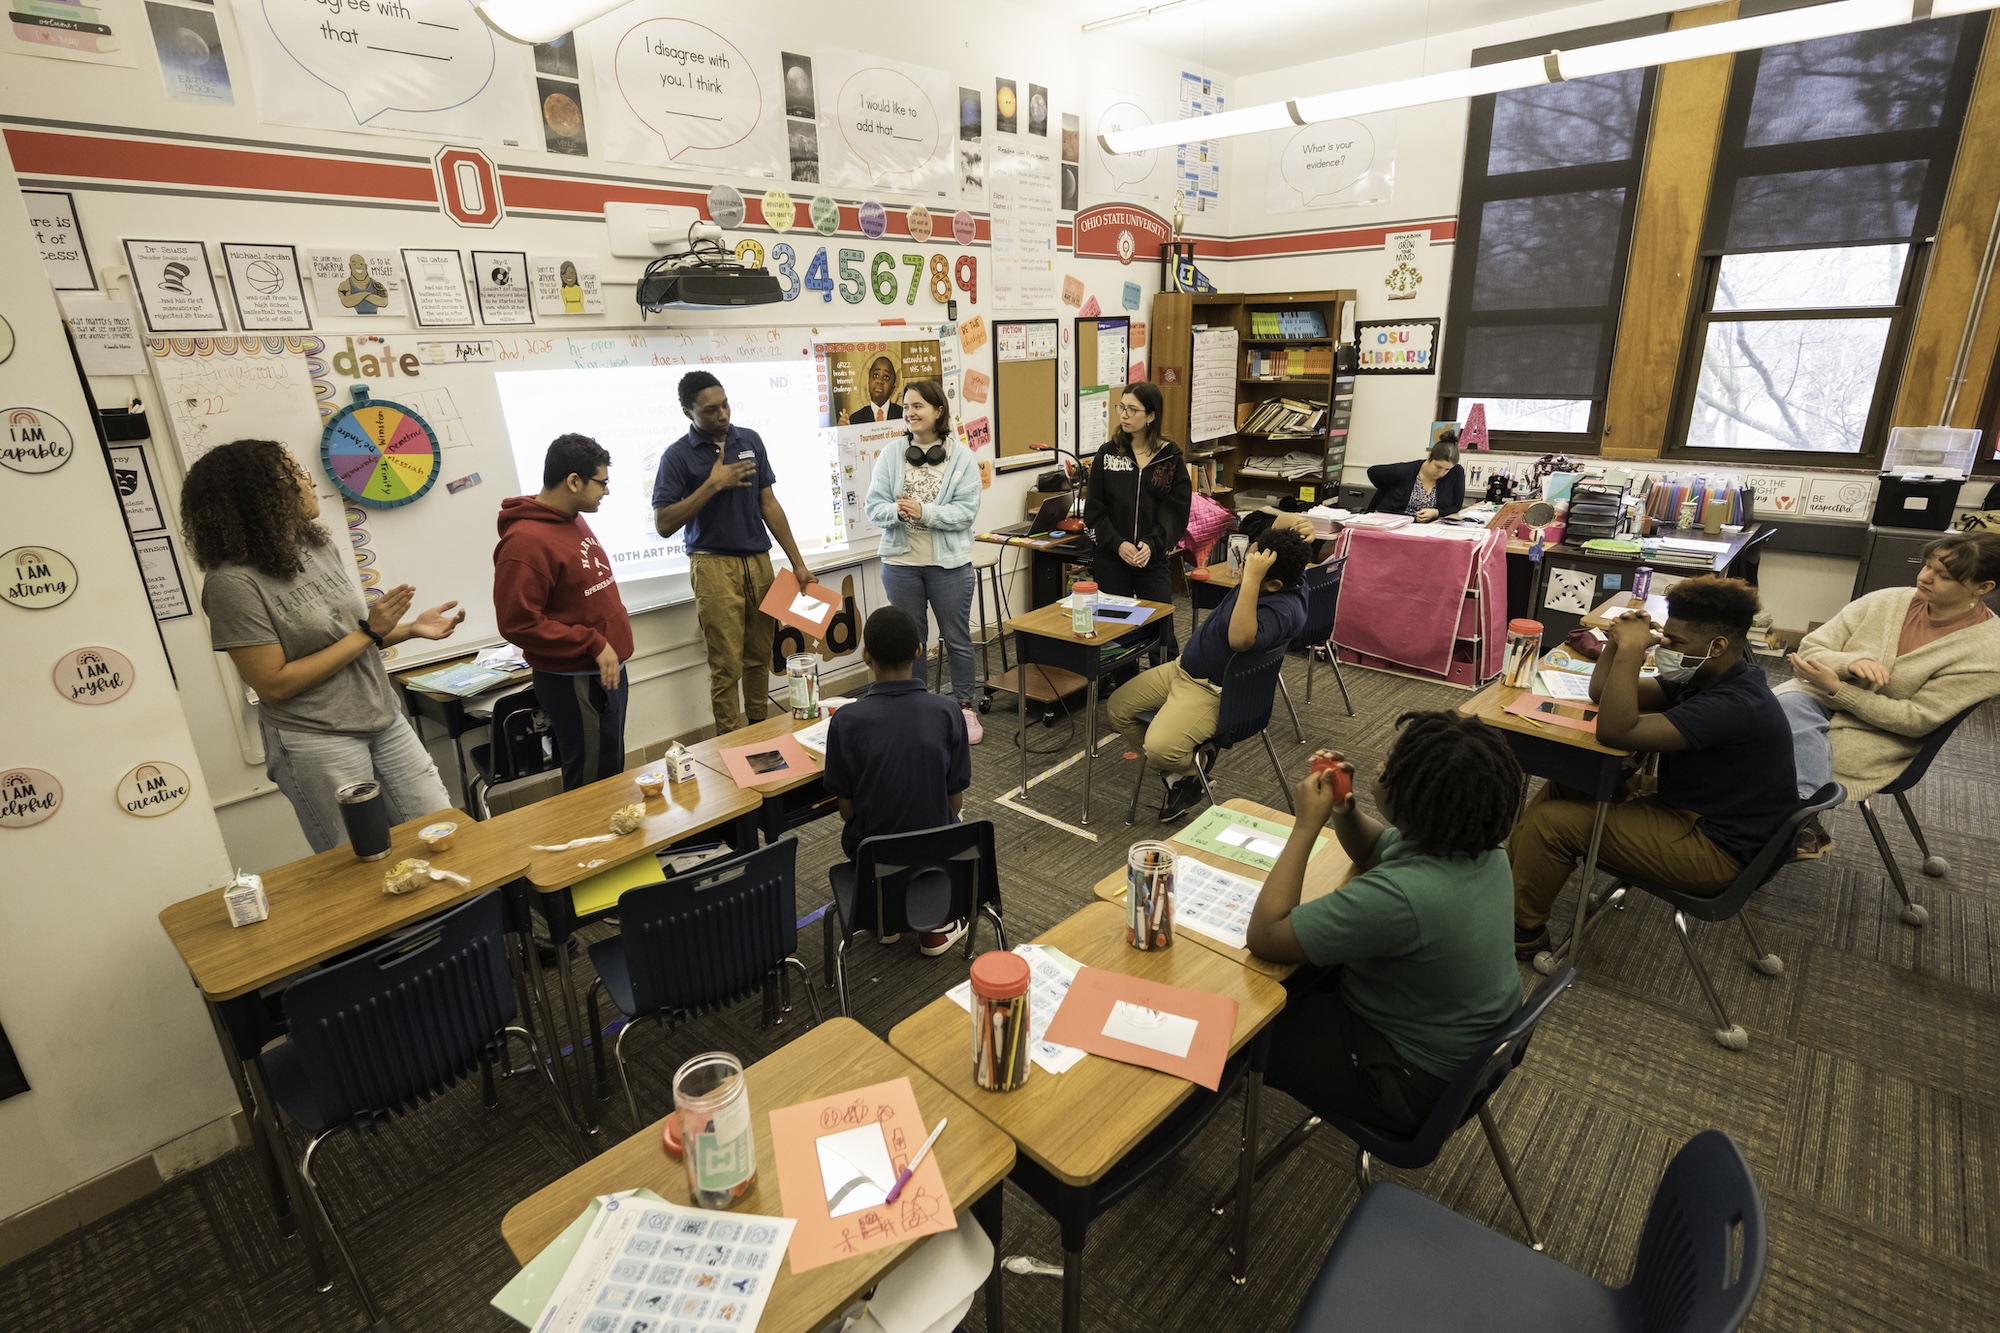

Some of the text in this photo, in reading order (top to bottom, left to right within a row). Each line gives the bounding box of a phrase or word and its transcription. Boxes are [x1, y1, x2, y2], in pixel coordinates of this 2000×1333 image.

[377, 0, 411, 20] with
[320, 20, 359, 45] that
[646, 36, 730, 69] I disagree with
[178, 75, 218, 88] EARTH'S
[185, 83, 215, 95] MOON
[660, 72, 723, 95] you. I think
[861, 94, 917, 118] I would like to
[856, 120, 893, 136] add that
[998, 146, 1015, 159] Reading
[1302, 140, 1354, 154] What is your
[1306, 155, 1346, 171] evidence?
[56, 216, 71, 228] is
[1081, 213, 1167, 239] OHIO STATE UNIVERSITY
[50, 234, 66, 245] of
[1398, 240, 1416, 251] GROW
[144, 246, 188, 255] Dr. Seuss
[264, 252, 291, 263] Jordan
[1396, 252, 1415, 263] MIND
[313, 262, 345, 273] POWERFUL
[429, 256, 449, 264] Gates
[772, 243, 801, 302] 3
[805, 246, 834, 303] 4
[838, 248, 867, 304] 5
[871, 251, 898, 305] 6
[903, 254, 924, 305] 7
[930, 253, 953, 304] 8
[956, 255, 978, 305] 9
[163, 305, 202, 313] manuscript
[243, 308, 277, 316] basketball
[254, 301, 290, 310] high school
[154, 313, 183, 321] rejected
[960, 317, 981, 336] BE THE
[1002, 326, 1022, 335] FICTION
[591, 339, 617, 353] open
[1377, 331, 1409, 345] OSU
[333, 336, 421, 379] date
[455, 343, 485, 362] April
[526, 339, 553, 357] 2025
[180, 358, 289, 382] Affirmations
[203, 395, 230, 415] 22
[10, 428, 46, 442] I AM
[378, 410, 386, 447] Winston
[966, 422, 989, 440] hard
[1459, 403, 1490, 451] A
[860, 431, 885, 443] Tournament
[886, 430, 891, 438] of
[381, 460, 391, 495] Trinity
[1751, 478, 1786, 489] DO THE
[1752, 486, 1777, 496] IGHT
[1753, 494, 1768, 504] ing
[1812, 494, 1825, 504] BE
[1809, 501, 1855, 515] respectful
[612, 543, 690, 563] 10TH ART PRO
[16, 564, 52, 581] I AM
[9, 581, 69, 599] strong
[826, 596, 858, 654] d
[77, 662, 110, 680] I AM
[71, 672, 124, 699] joyful
[137, 775, 167, 794] I AM
[2, 784, 37, 802] I AM
[127, 786, 188, 812] creative
